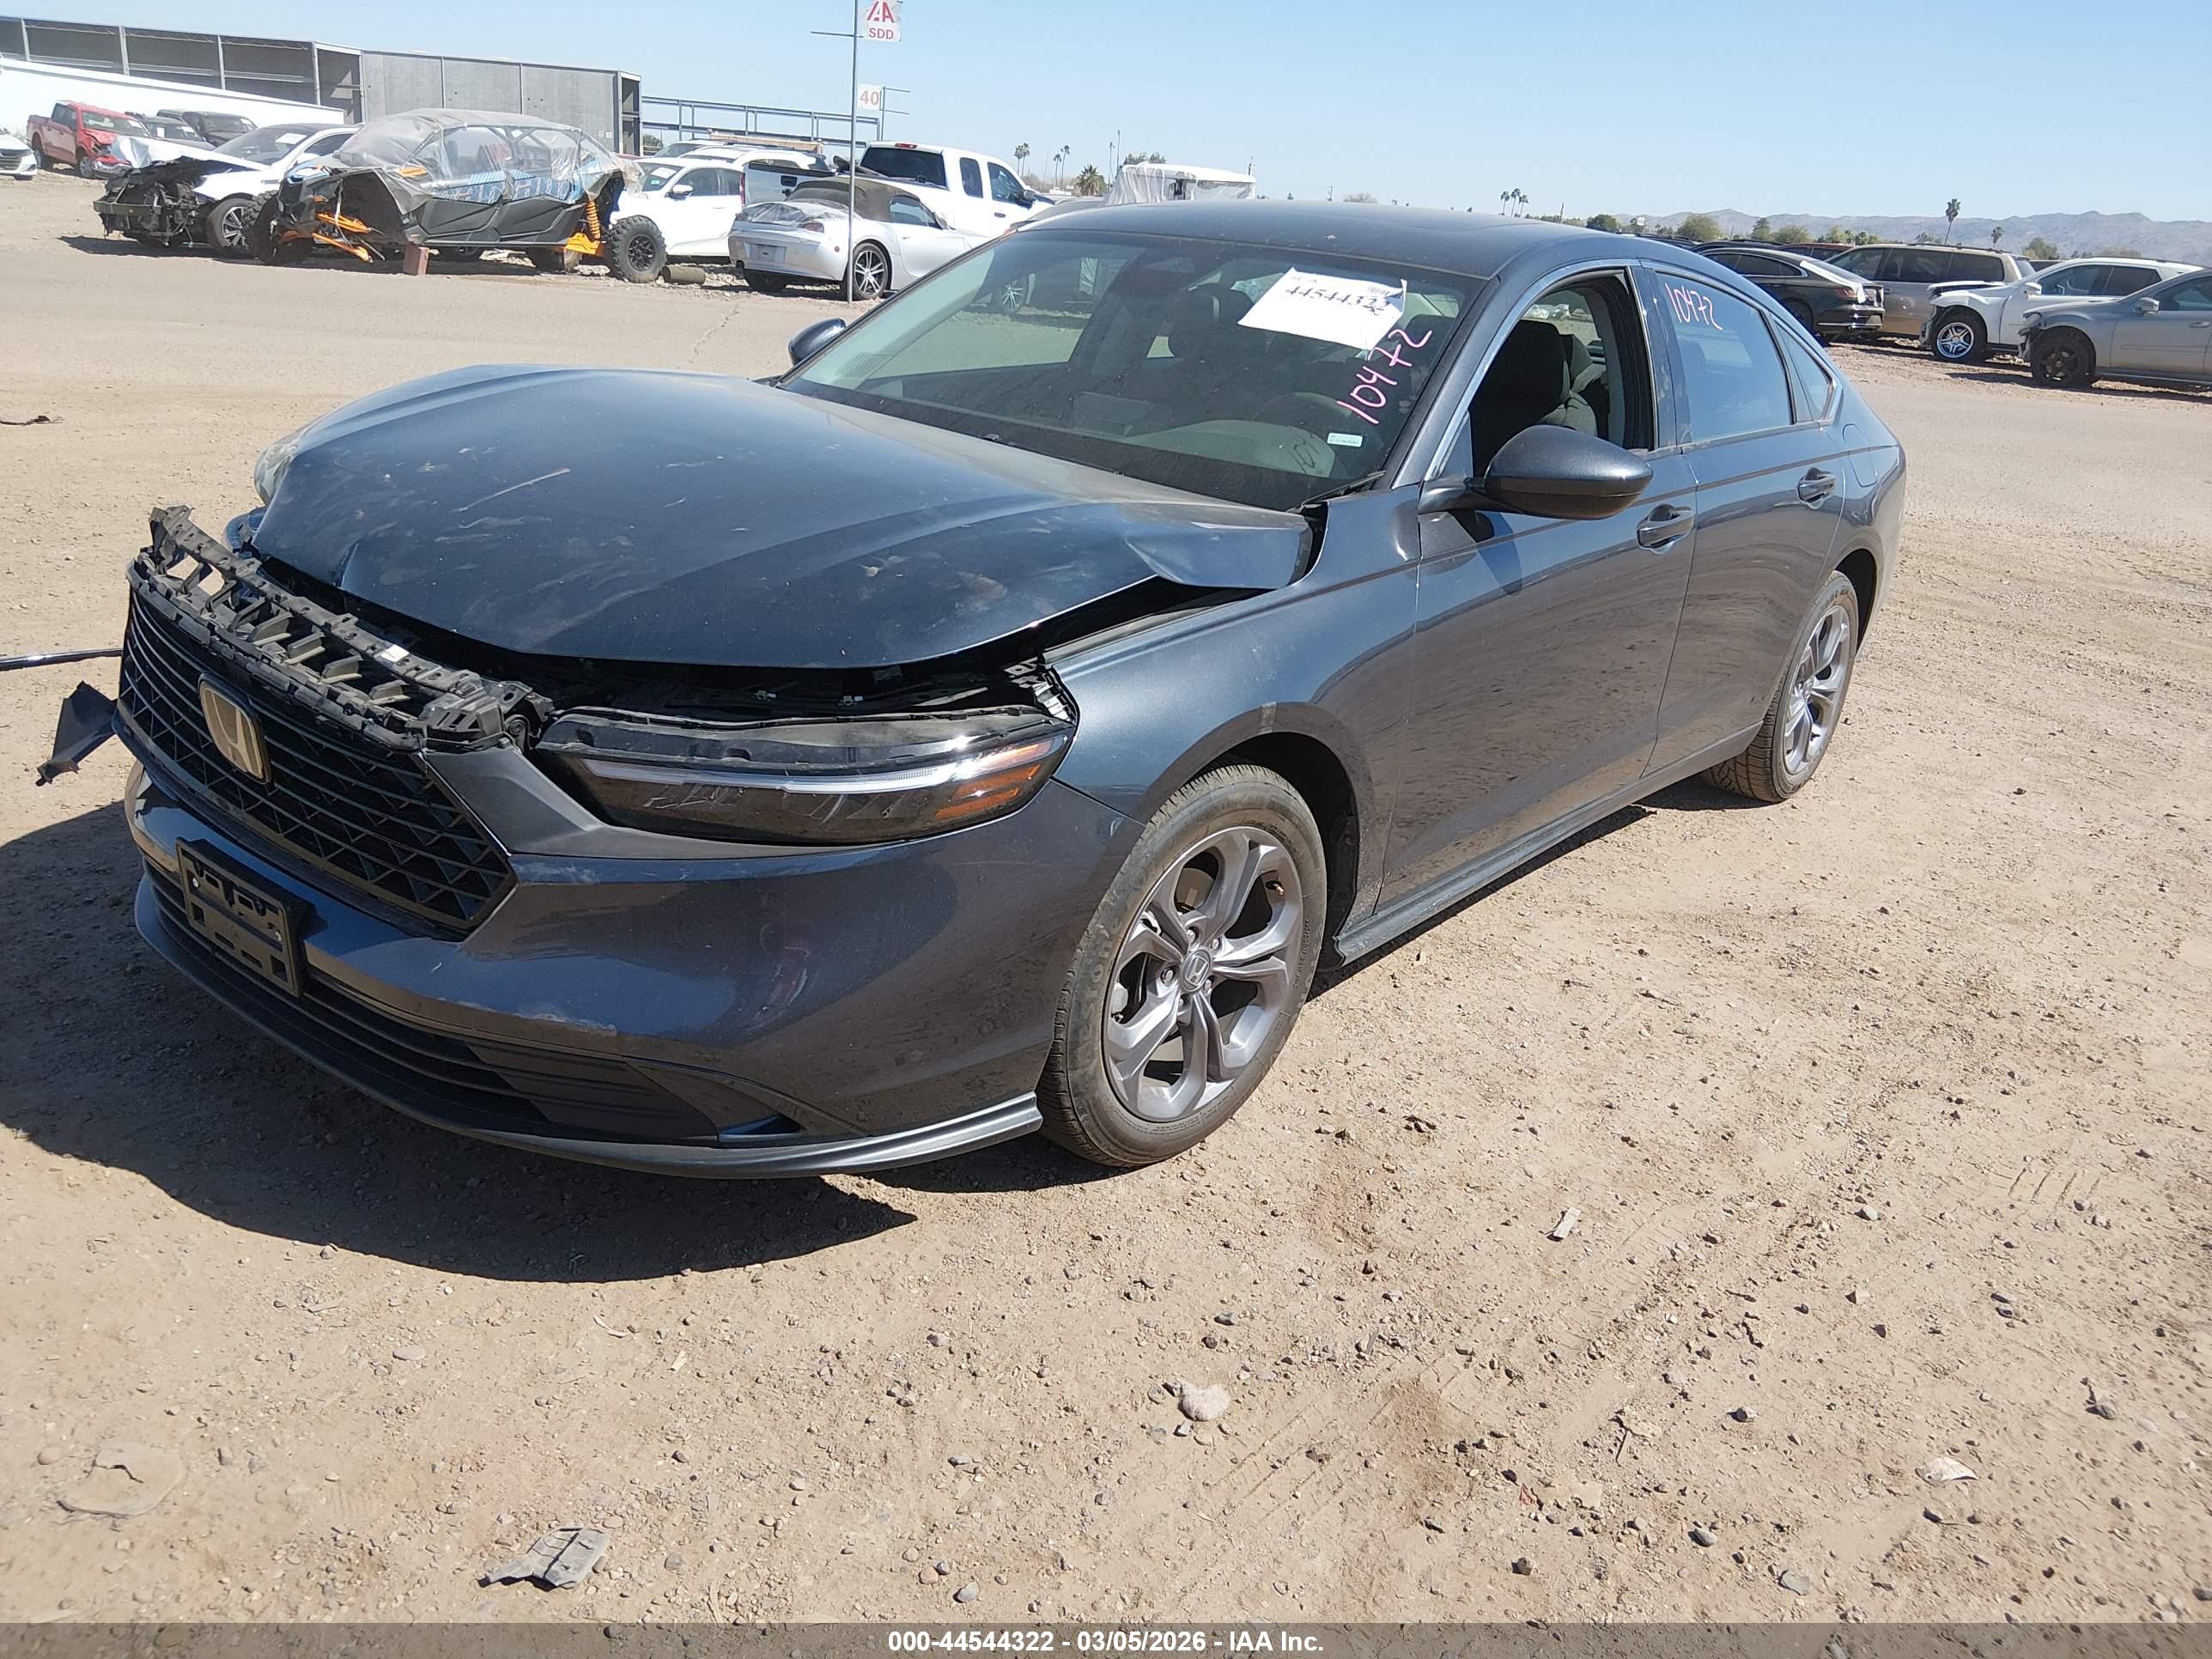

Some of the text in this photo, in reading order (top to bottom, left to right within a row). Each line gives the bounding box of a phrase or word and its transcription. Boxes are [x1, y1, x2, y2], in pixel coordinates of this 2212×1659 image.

[868, 27, 894, 40] SDD
[860, 89, 879, 106] 40
[1664, 282, 1723, 331] 10472
[1336, 329, 1432, 424] 10472
